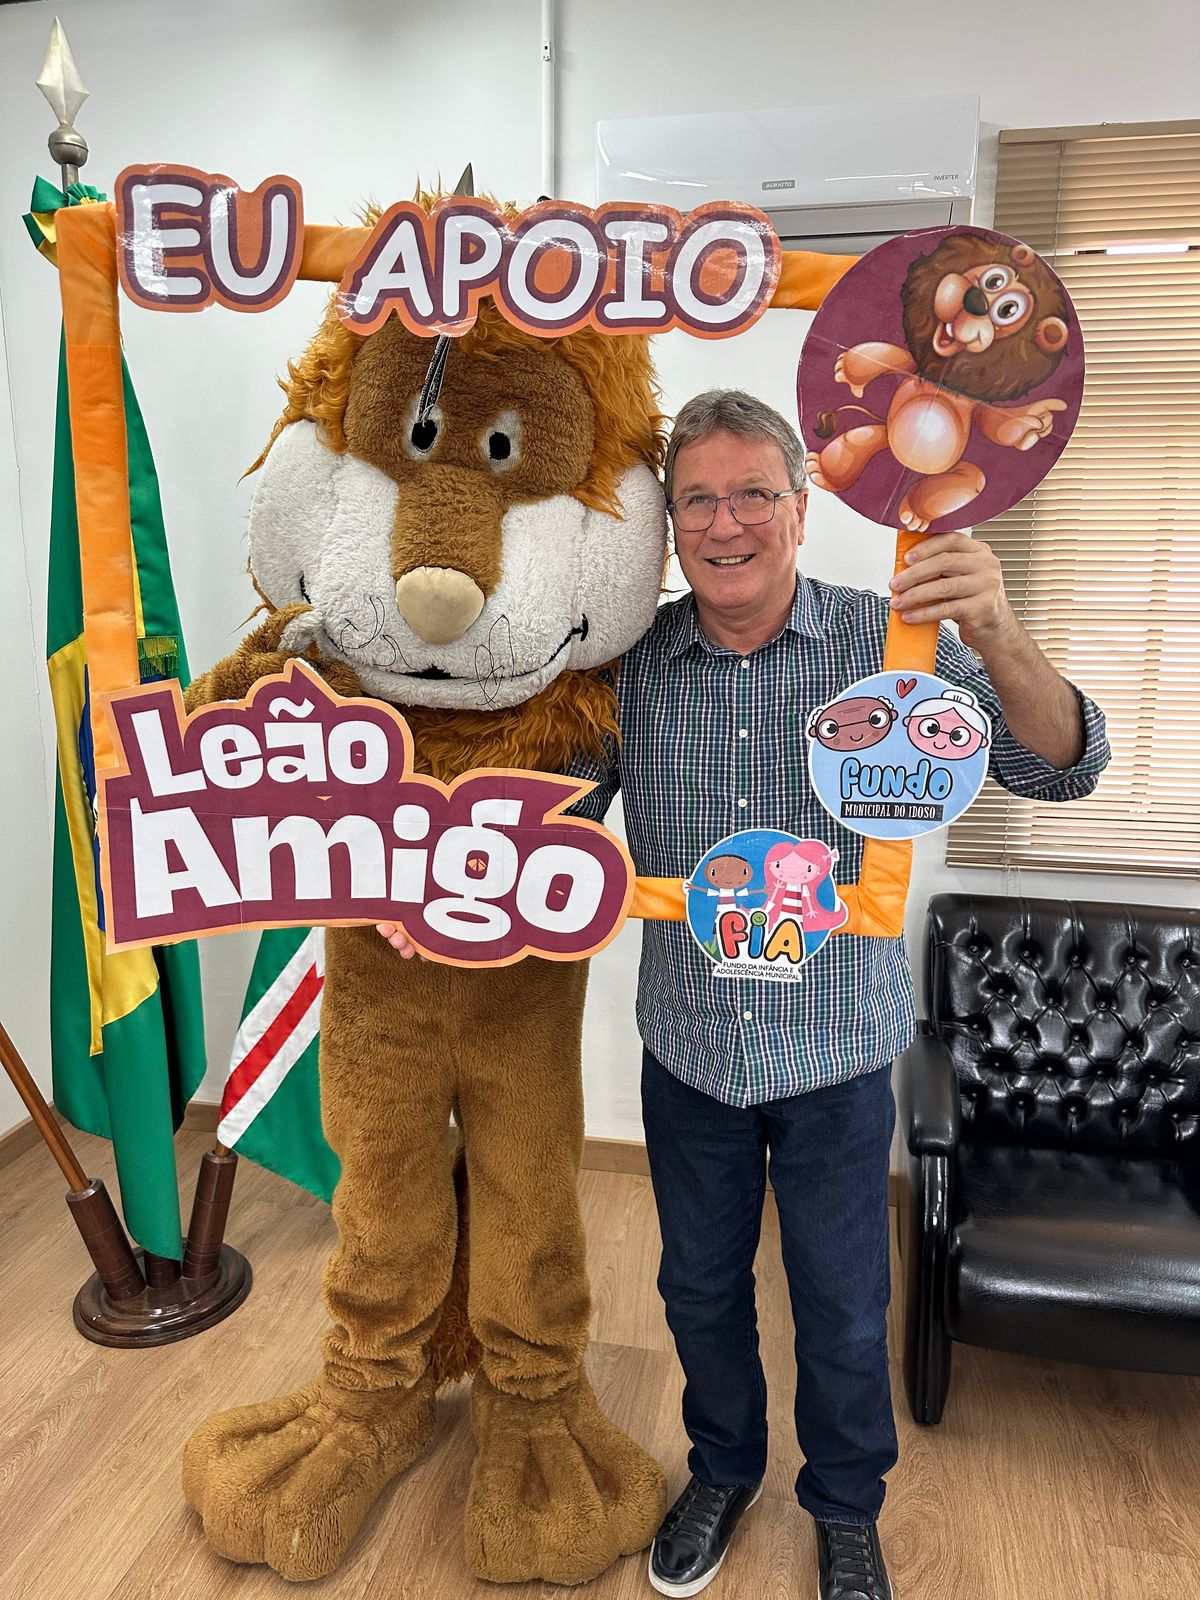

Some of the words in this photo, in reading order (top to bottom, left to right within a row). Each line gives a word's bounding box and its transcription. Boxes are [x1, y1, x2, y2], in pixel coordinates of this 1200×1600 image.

[130, 182, 290, 298] EU
[354, 213, 768, 325] APOIO
[129, 696, 389, 797] Leão
[844, 803, 891, 818] MUNICIPAL
[894, 804, 906, 818] DO
[908, 805, 936, 819] IDOSO
[129, 797, 606, 943] Amigo
[716, 967, 764, 977] ADOLESCÊNCIA
[765, 971, 800, 981] MUNICIPAL
[723, 961, 747, 970] FUNDO
[758, 964, 789, 973] INFÂNCIA
